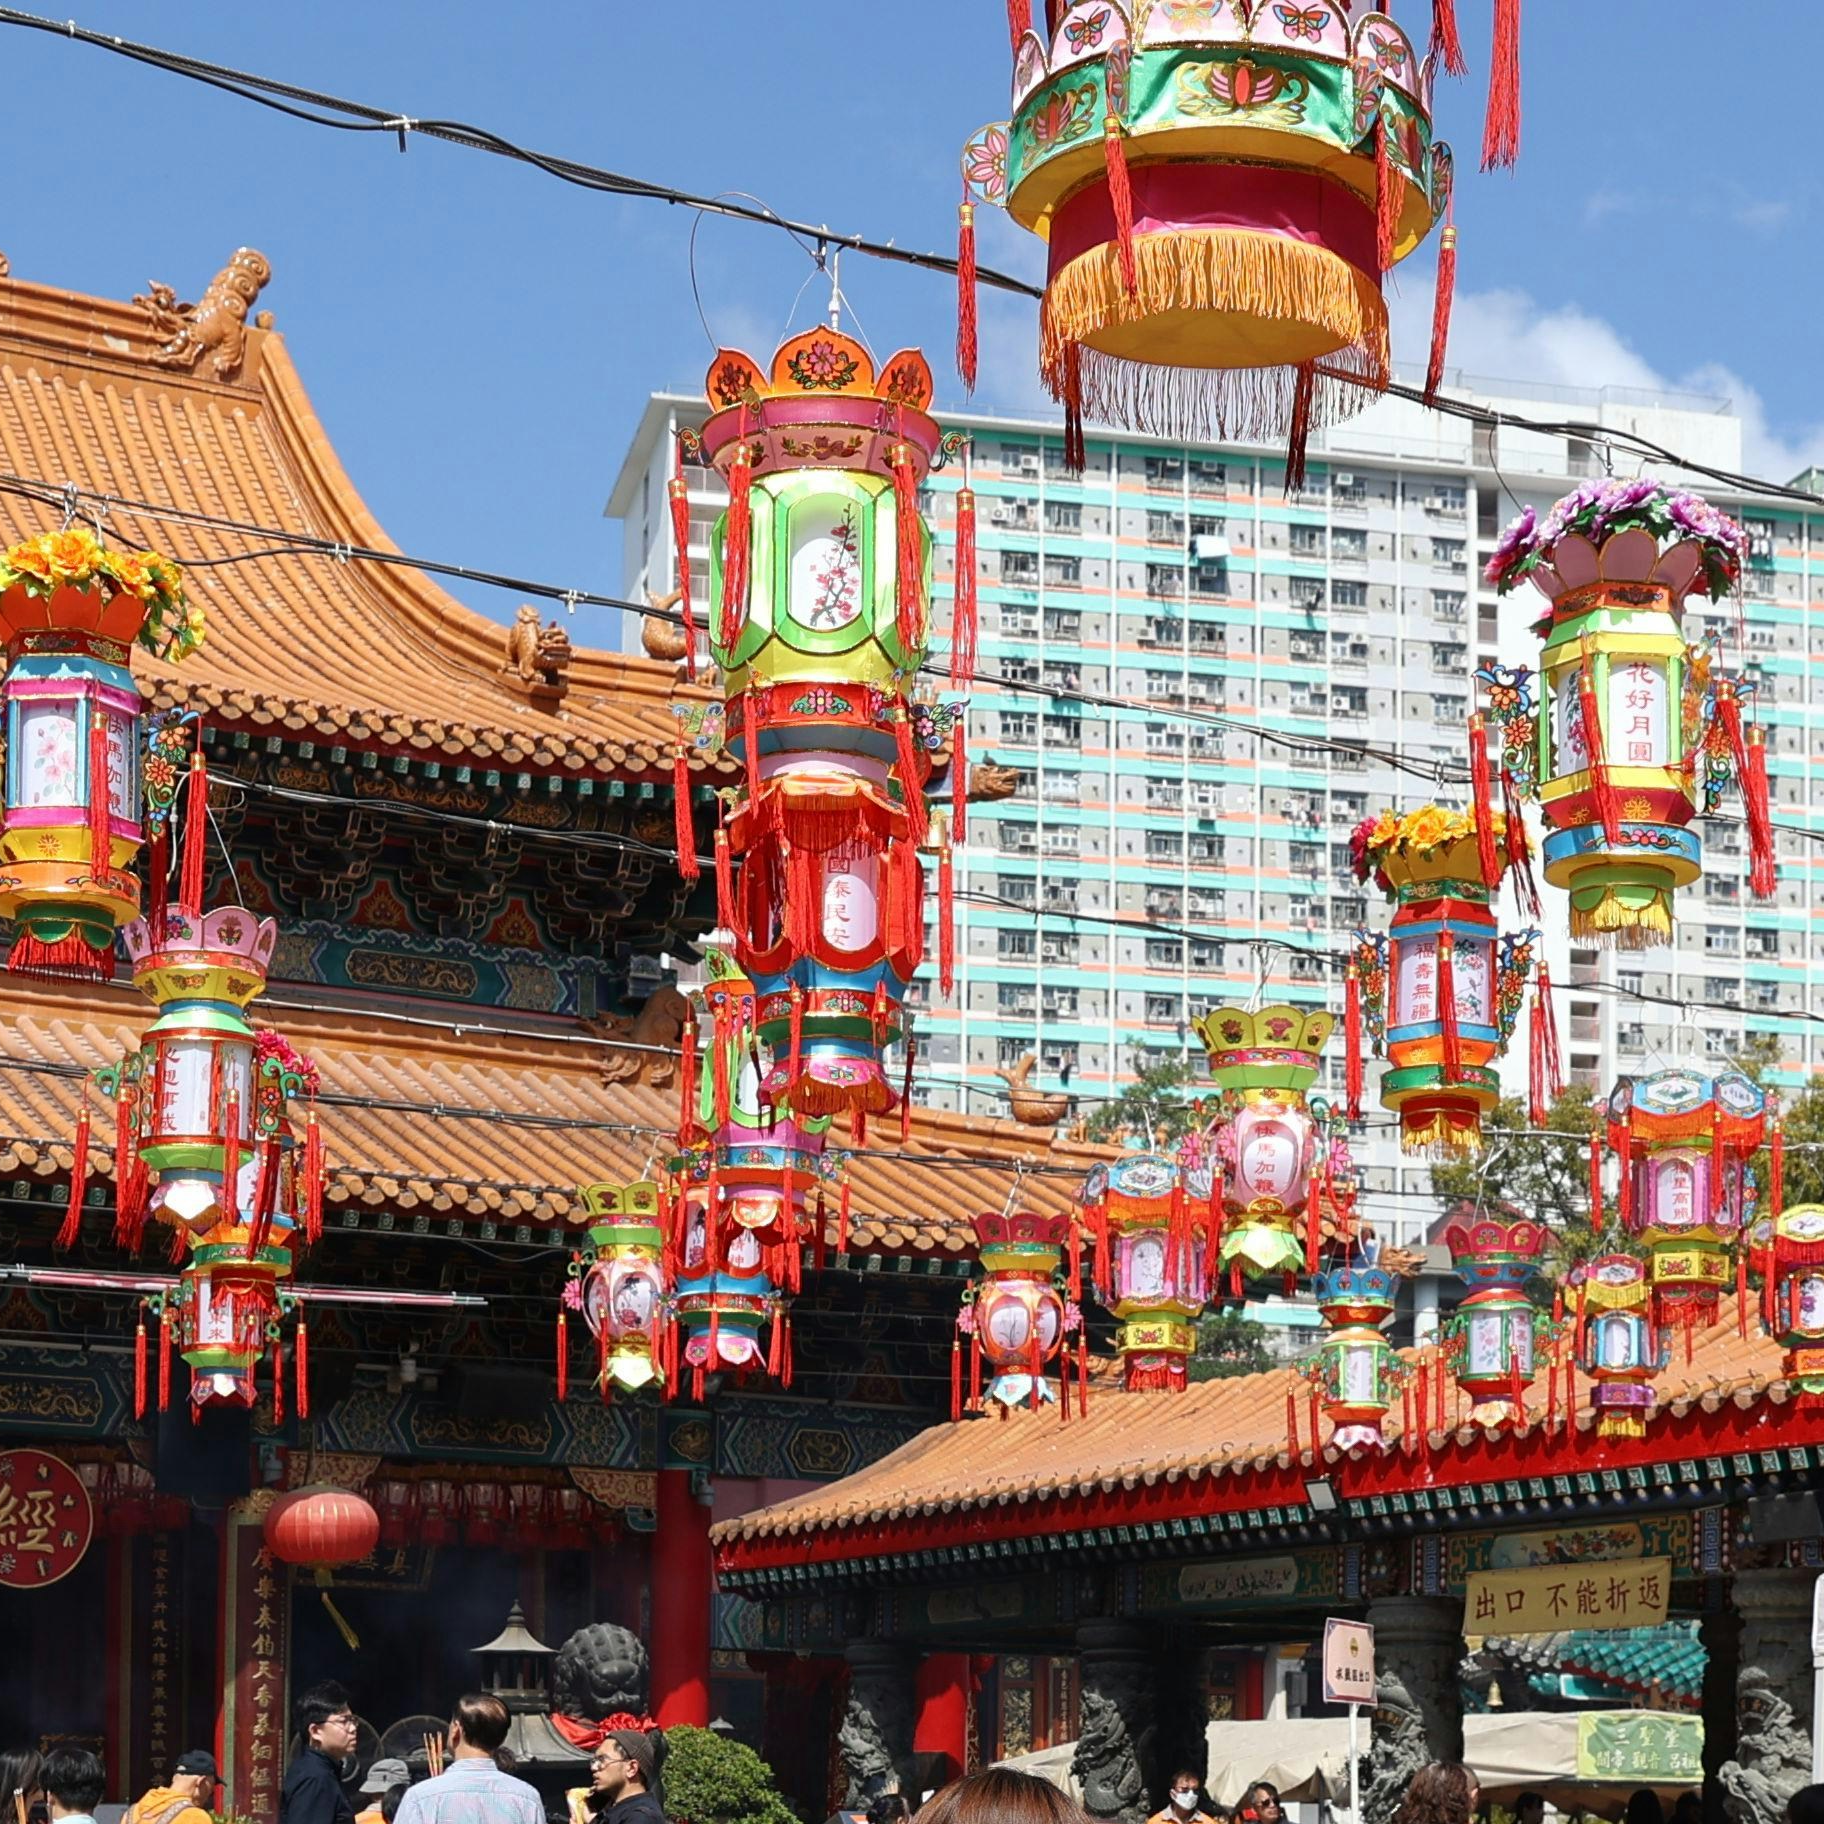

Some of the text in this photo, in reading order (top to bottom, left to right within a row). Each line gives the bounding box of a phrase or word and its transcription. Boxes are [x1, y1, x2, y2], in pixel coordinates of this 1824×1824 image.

[1624, 661, 1654, 764] 花好月圓
[826, 855, 852, 947] 國泰民安
[1409, 942, 1435, 1019] 福壽無疆
[1476, 1576, 1663, 1620] 出口 不能折返
